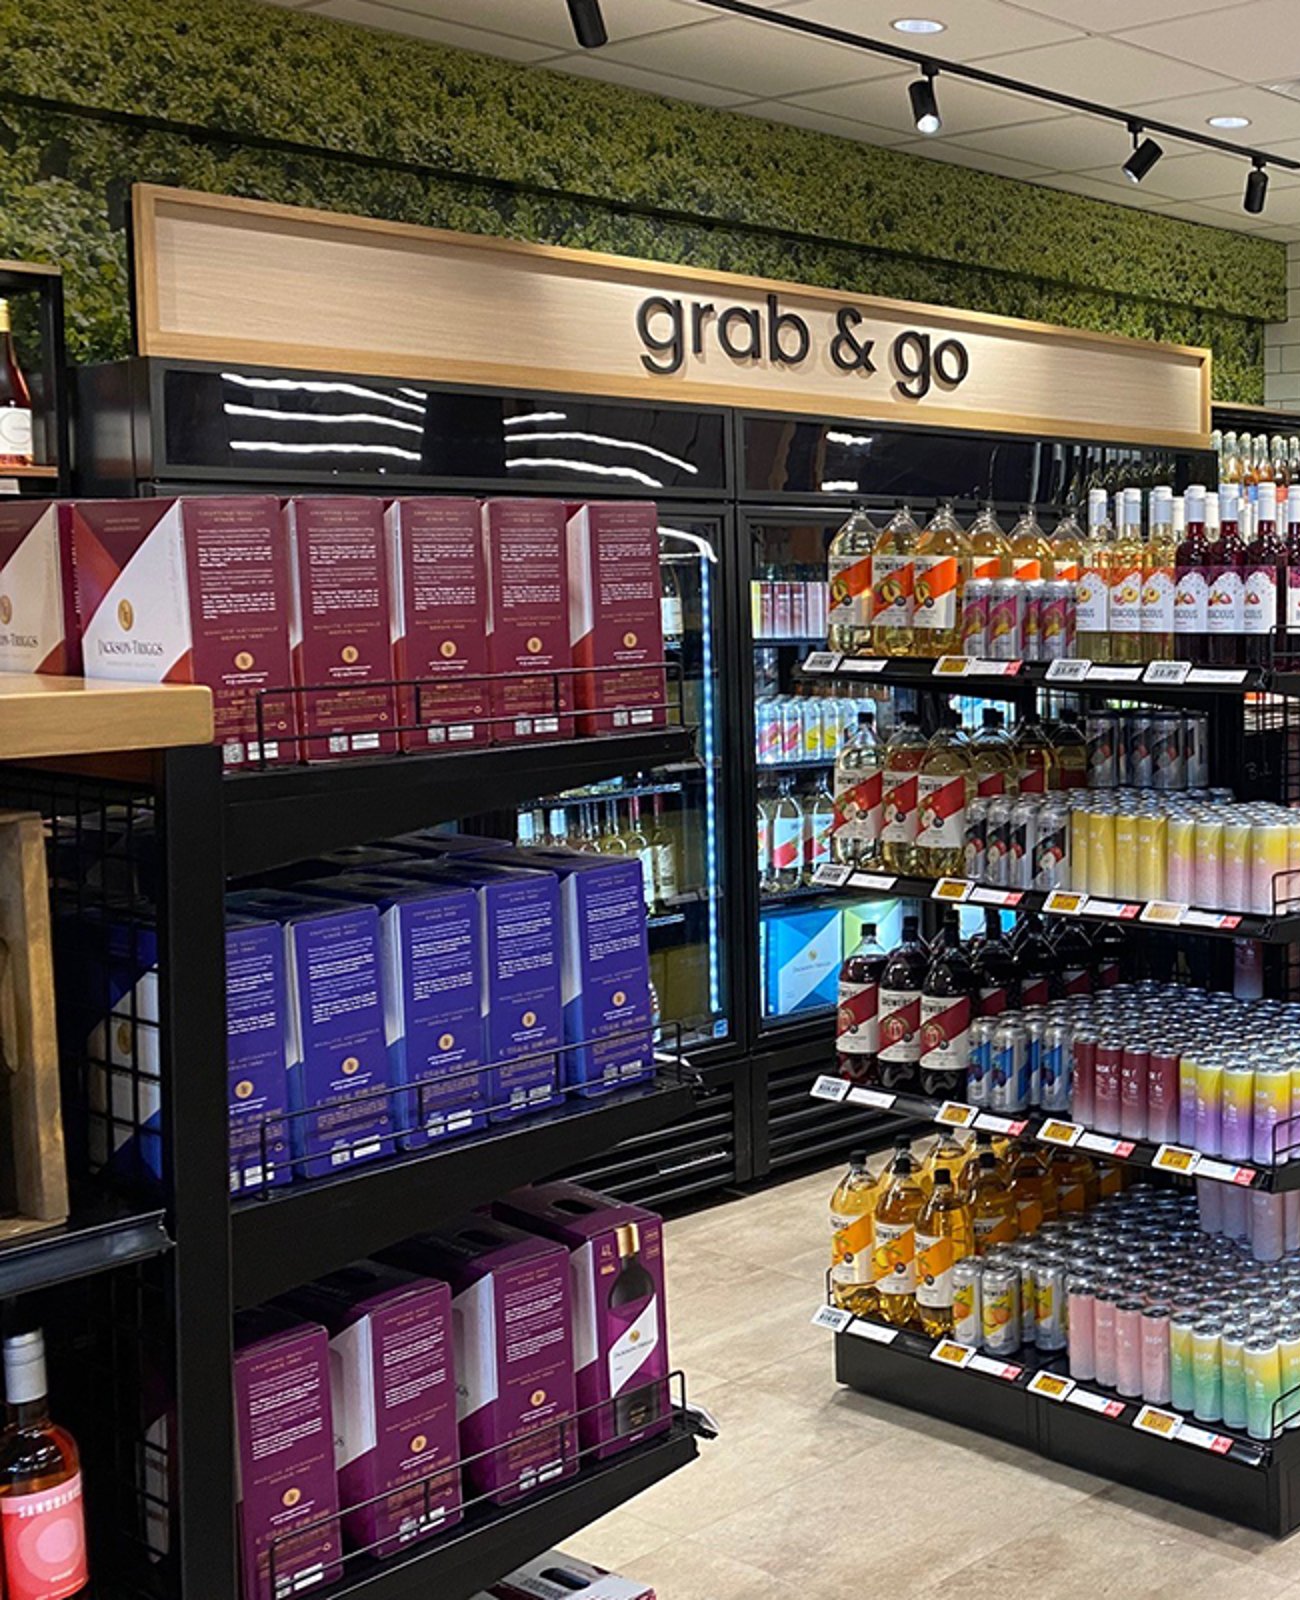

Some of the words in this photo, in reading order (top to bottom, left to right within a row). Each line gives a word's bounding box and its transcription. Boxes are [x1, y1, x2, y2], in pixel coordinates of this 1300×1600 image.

[637, 295, 812, 374] grab
[830, 307, 877, 373] &
[893, 330, 970, 400] go
